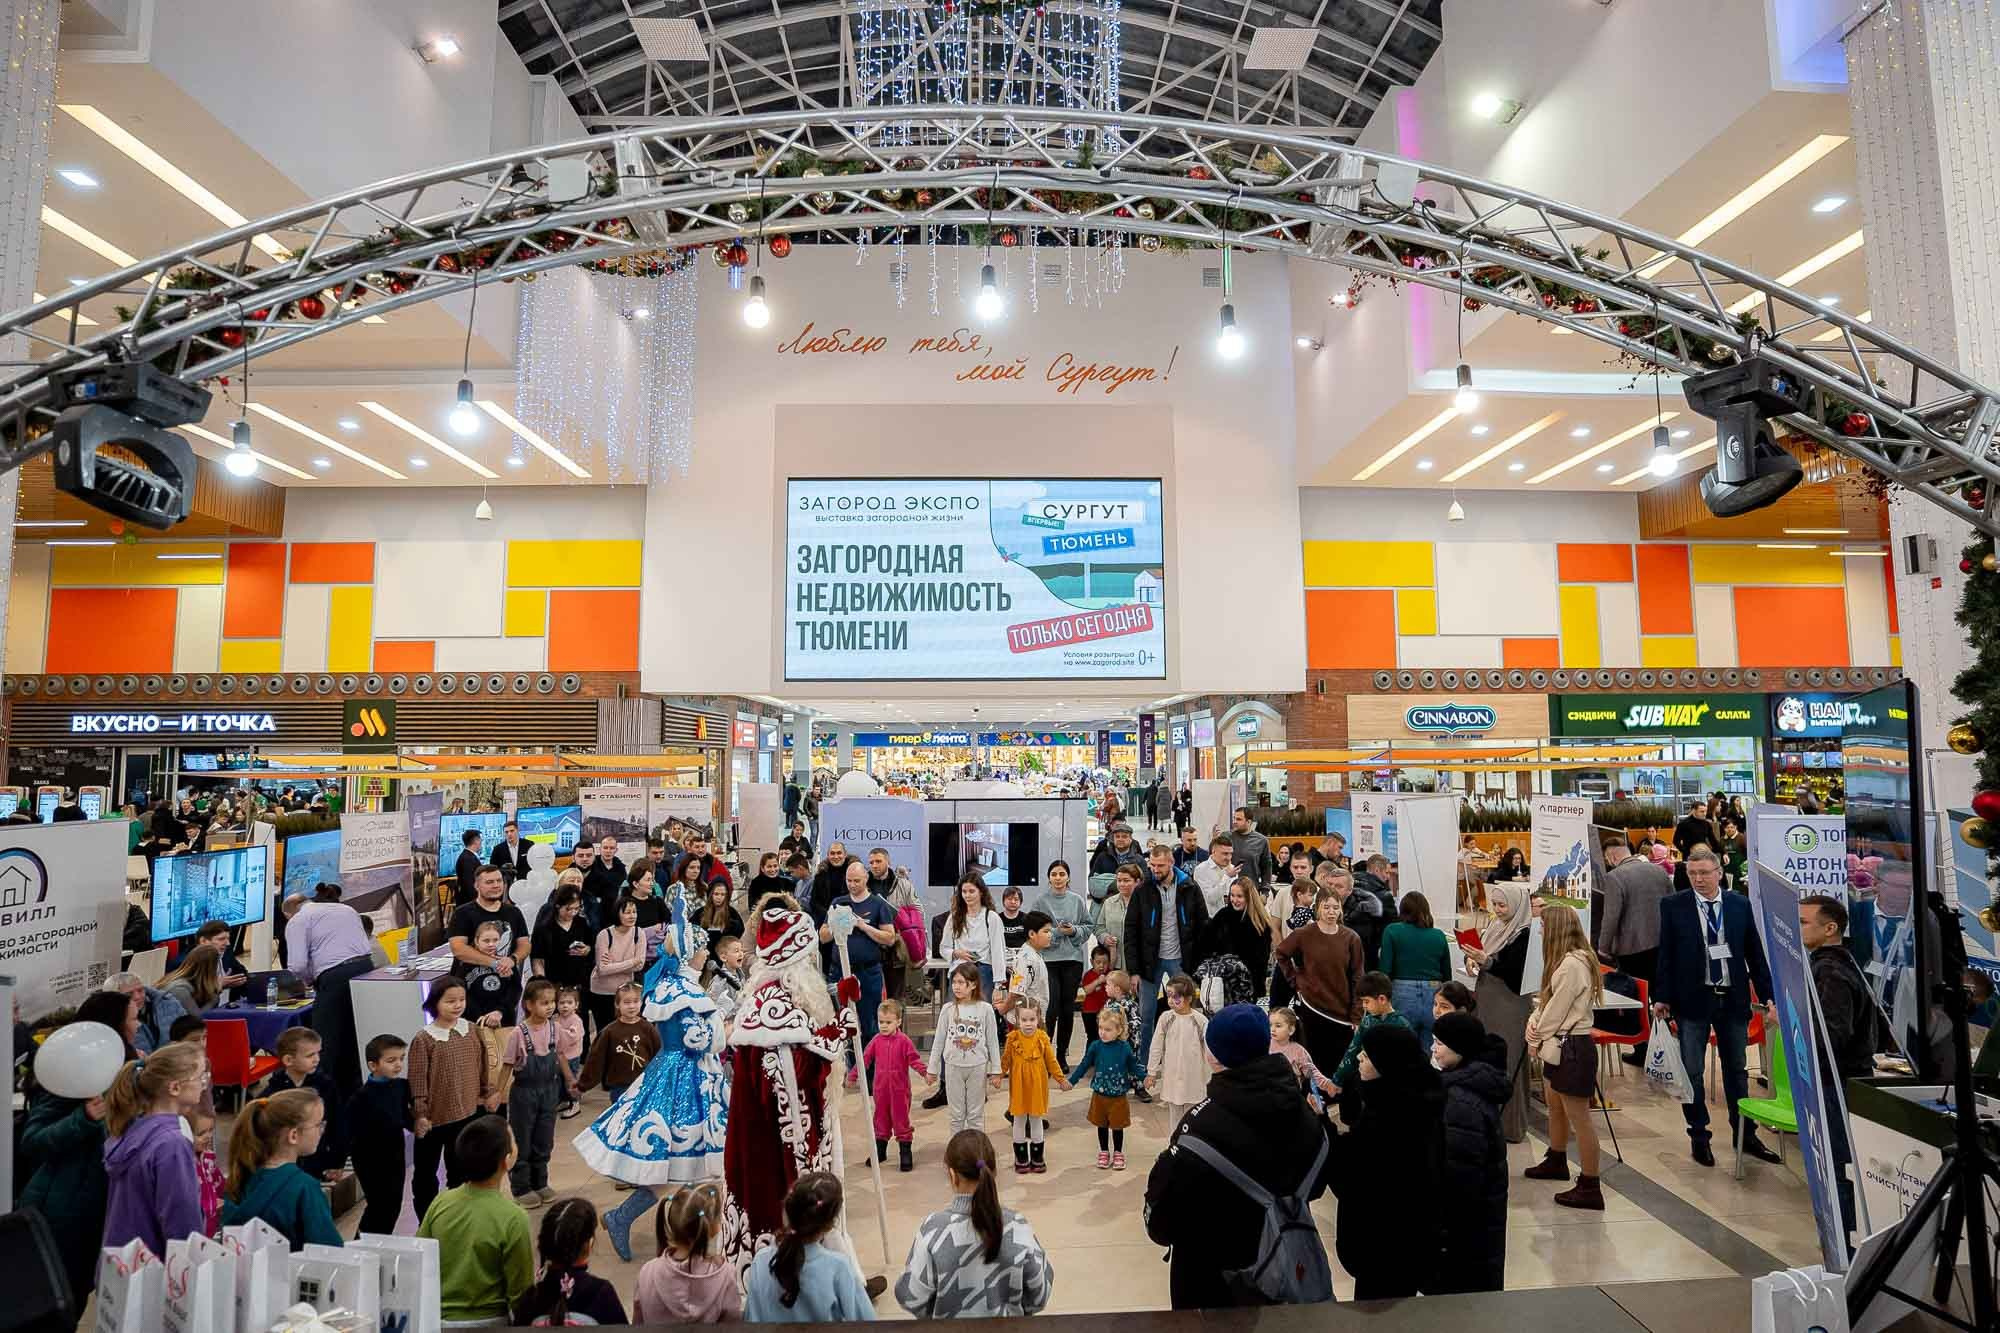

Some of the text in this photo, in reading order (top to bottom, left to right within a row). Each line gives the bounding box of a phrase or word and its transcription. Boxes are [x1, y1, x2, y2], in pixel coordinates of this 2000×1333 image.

[777, 322, 993, 359] Люблю тебя,
[956, 356, 1030, 382] мой
[799, 496, 980, 510] ЗАГОРОД ЭКСПО
[815, 514, 864, 522] выставка
[866, 514, 928, 524] загородной
[1043, 504, 1128, 519] СУРГУТ
[1049, 532, 1128, 551] ТЮМЕНЬ
[797, 544, 963, 577] ЗАГОРОДНАЯ
[796, 582, 1012, 616] НЕДВИЖИМОСТЬ
[795, 620, 908, 650] ТЮМЕНИ
[1009, 607, 1148, 649] ТОЛЬКО СЕГОДНЯ
[1138, 649, 1156, 666] 0+
[1412, 711, 1490, 725] CINNABON
[1567, 711, 1617, 721] СЭНДВИЧИ
[1625, 703, 1709, 727] SUBWAY
[1715, 710, 1750, 719] САЛАТЫ
[72, 715, 160, 731] ВКУСНО
[203, 715, 276, 731] ТОЧКА
[889, 733, 968, 745] гипер лента
[1548, 805, 1584, 816] партнер
[834, 828, 912, 841] ИСТОРИЯ
[1784, 872, 1848, 885] АНАЛ
[19, 920, 98, 945] ЗАГОРОДНОЙ
